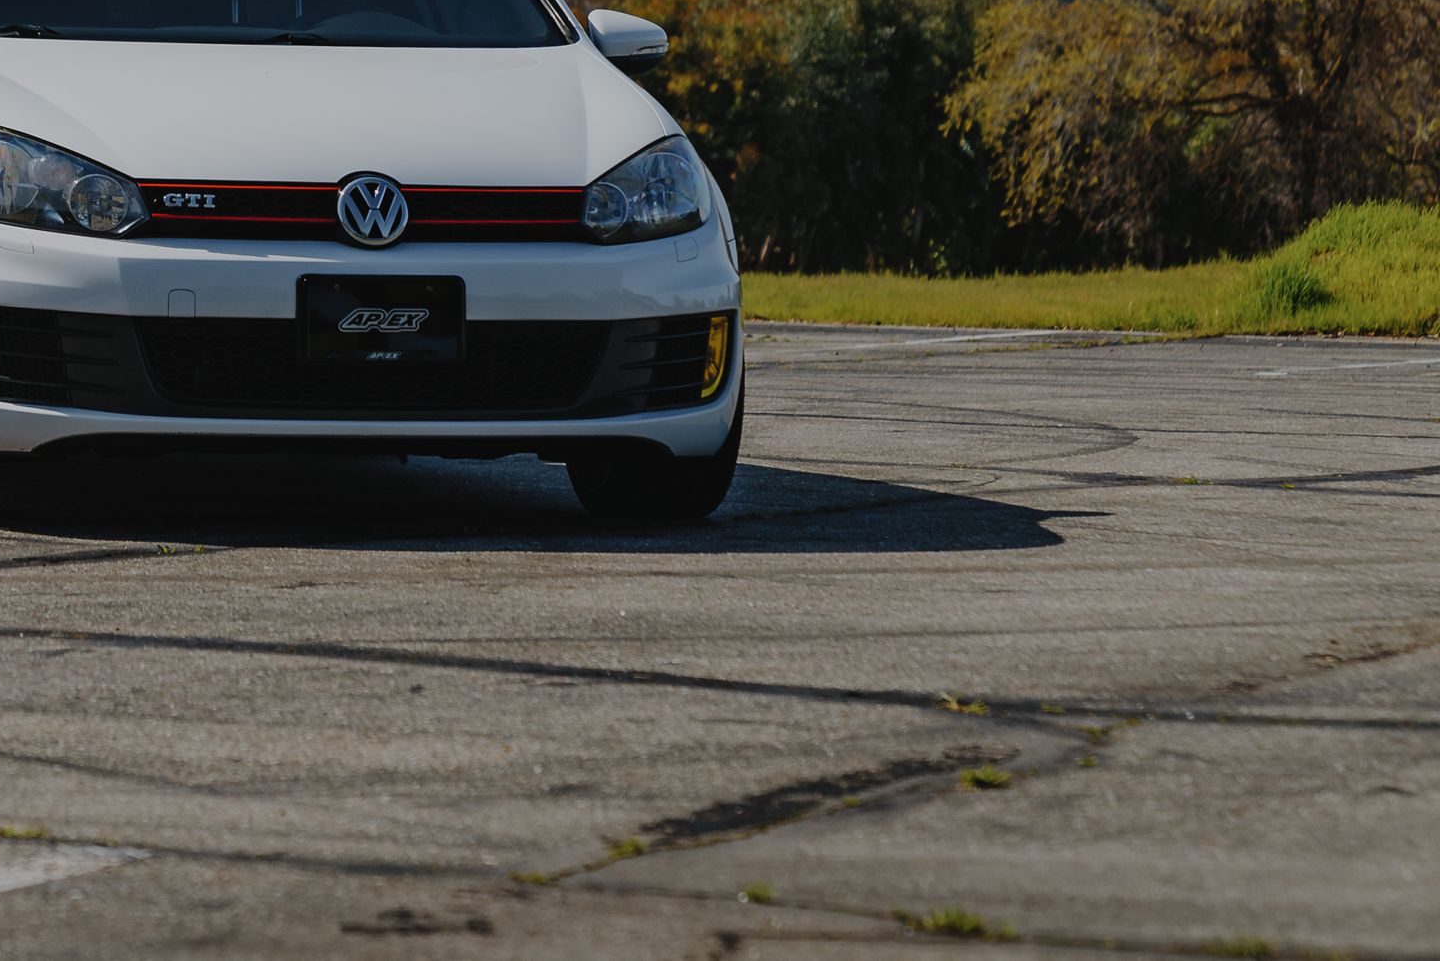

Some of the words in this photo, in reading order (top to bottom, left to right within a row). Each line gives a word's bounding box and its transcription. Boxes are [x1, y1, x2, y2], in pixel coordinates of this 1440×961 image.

[163, 193, 216, 208] GTI
[342, 179, 405, 240] VW
[340, 309, 427, 331] APEX
